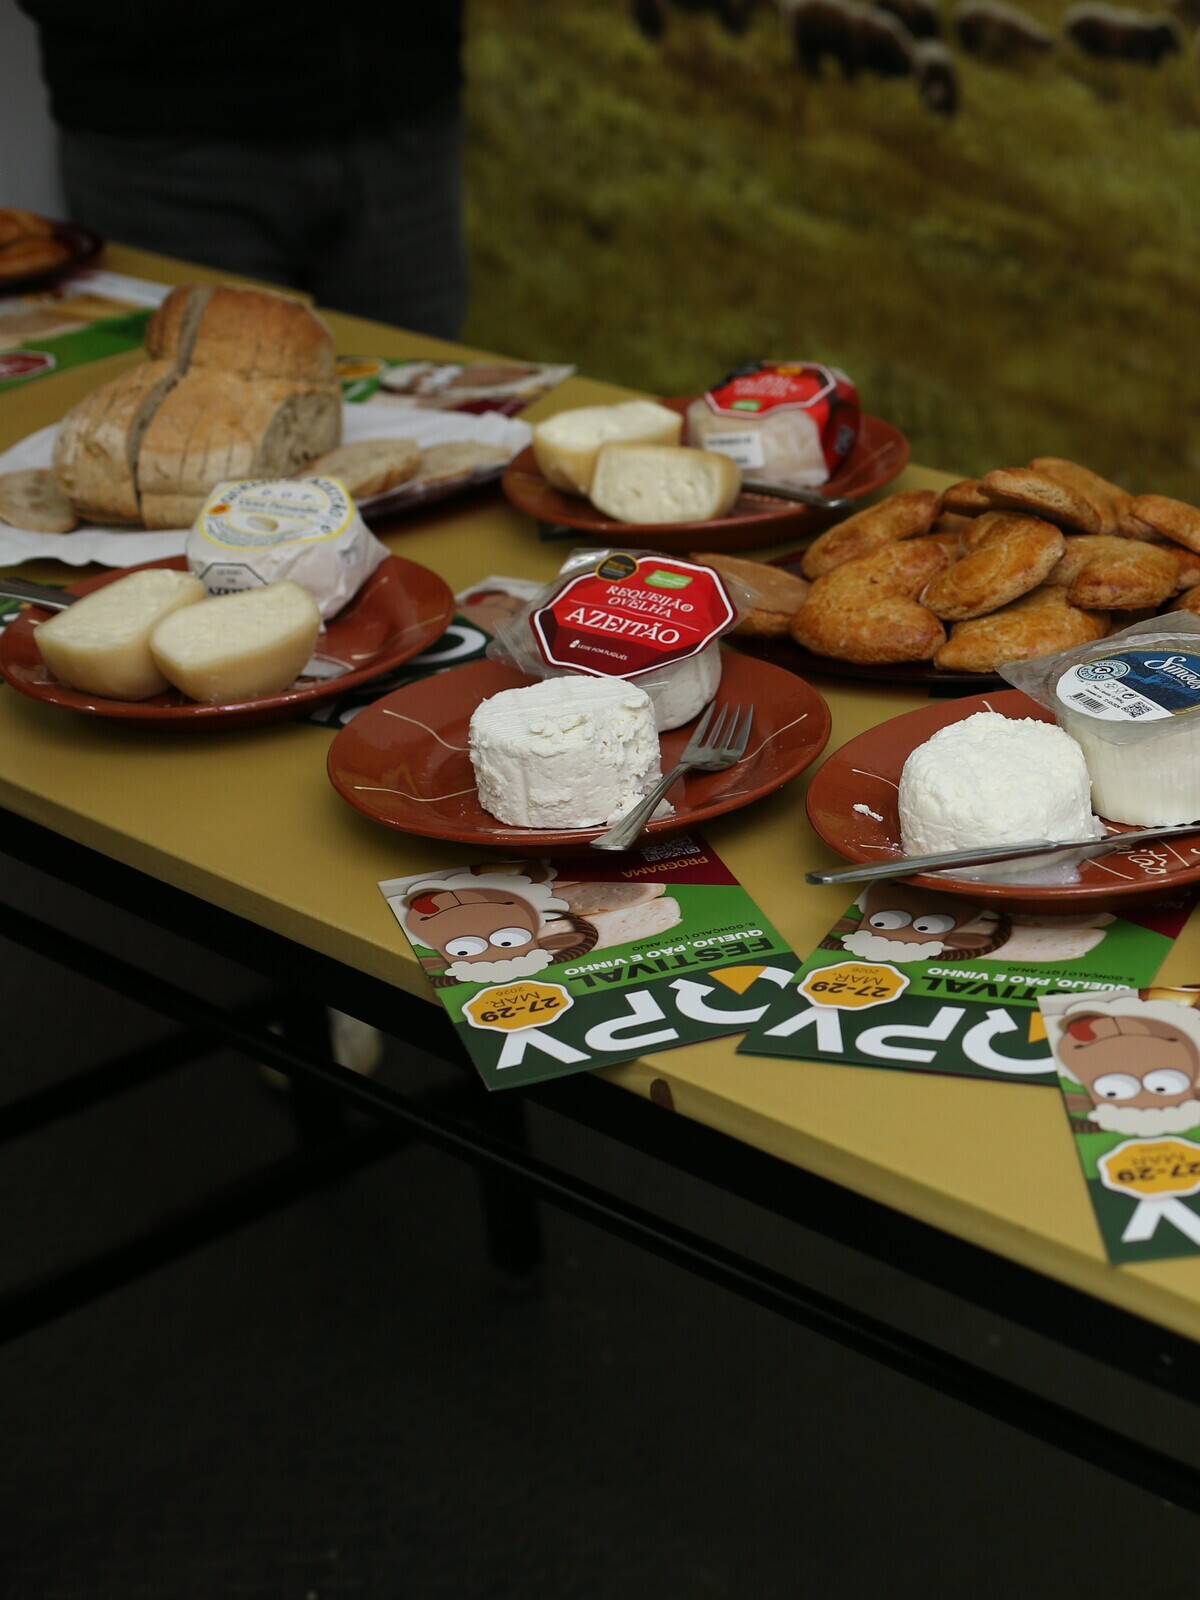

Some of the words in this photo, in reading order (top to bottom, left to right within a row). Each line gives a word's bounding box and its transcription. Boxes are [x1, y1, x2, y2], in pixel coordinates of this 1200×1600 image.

[606, 585, 695, 613] REQUEIJÃO
[607, 597, 672, 618] OVELHA
[565, 606, 681, 645] AZEITÃO
[621, 855, 710, 879] PROGRAMA
[686, 928, 765, 949] QUEIJO,
[689, 923, 746, 940] GONÇALO
[631, 937, 662, 951] ANJO
[646, 944, 687, 958] PÃO
[563, 955, 624, 976] VINHO
[567, 936, 776, 988] FESTIVAL
[630, 952, 644, 963] E
[832, 971, 884, 986] MAR.
[927, 967, 989, 982] VINHO
[992, 973, 1006, 982] E
[1007, 966, 1037, 974] ANJO
[811, 980, 891, 999] 27-29
[1008, 974, 1051, 987] PÃO
[484, 990, 540, 1008] MAR.
[496, 986, 525, 997] 2026
[480, 996, 562, 1024] 27-29
[496, 965, 796, 1071] QPV
